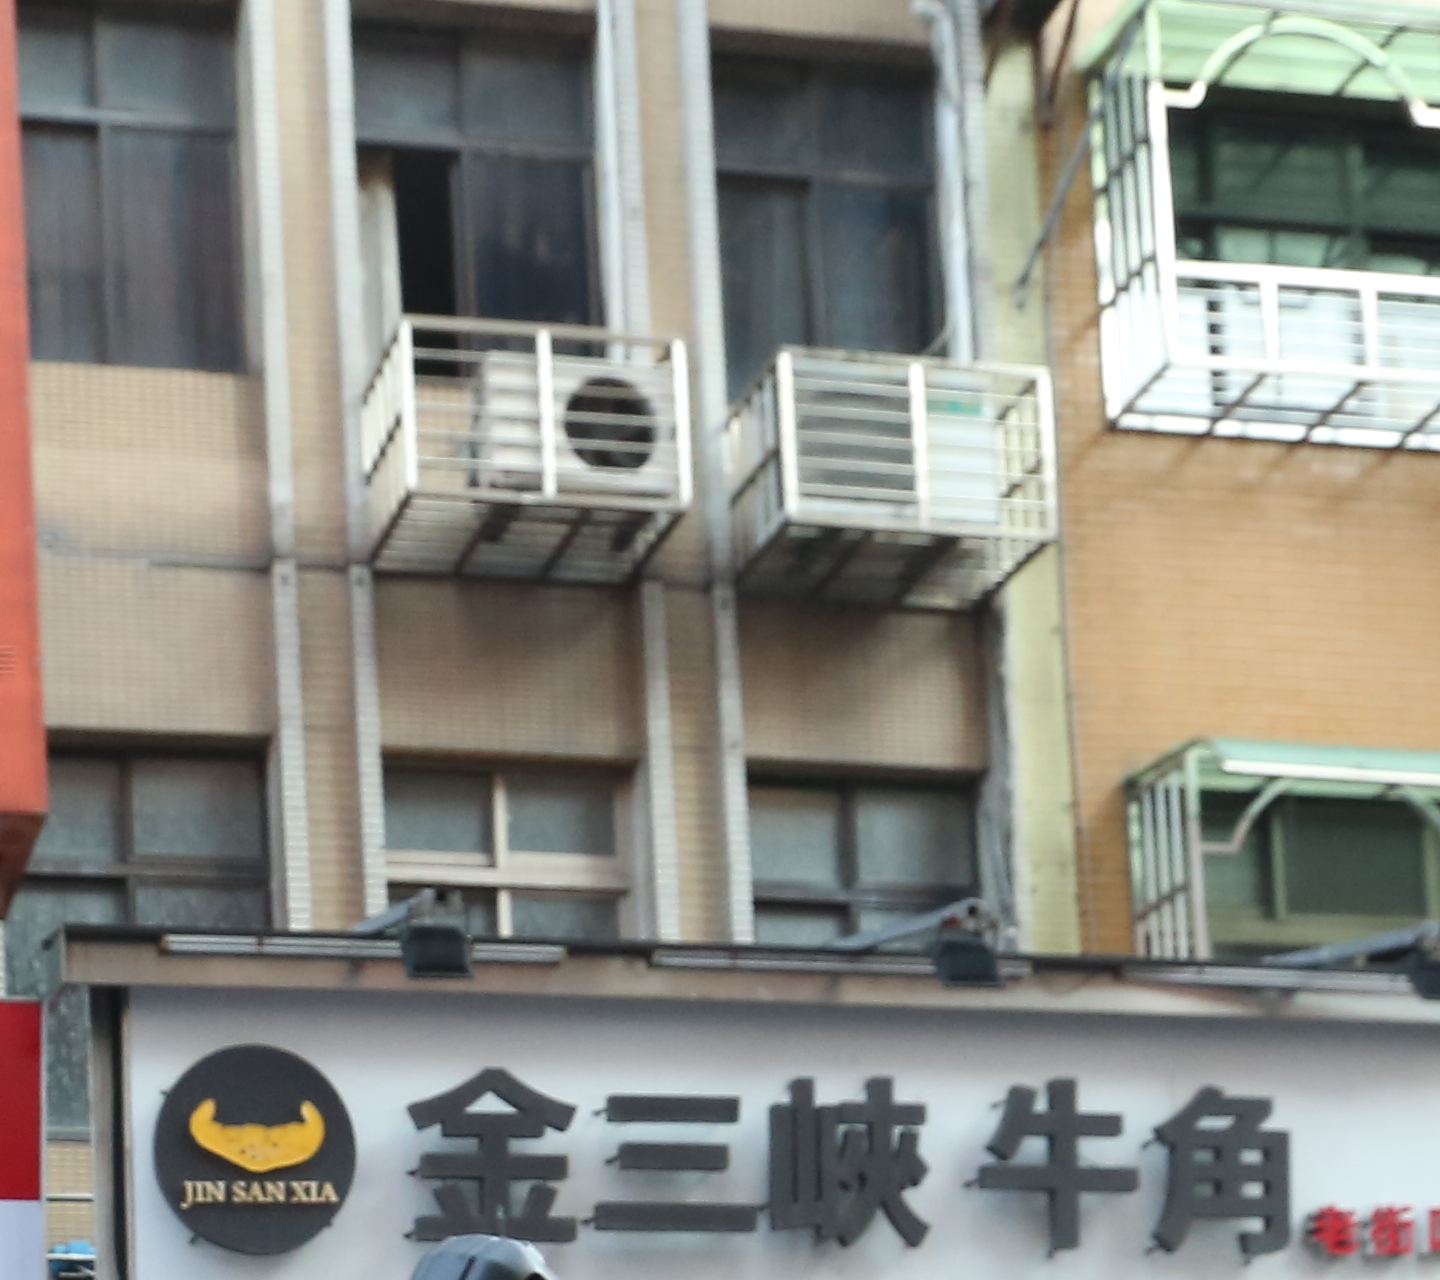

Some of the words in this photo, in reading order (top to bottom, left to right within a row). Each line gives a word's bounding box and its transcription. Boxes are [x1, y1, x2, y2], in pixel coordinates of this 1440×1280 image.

[180, 1179, 227, 1211] JIN
[231, 1179, 287, 1204] SAN
[289, 1179, 341, 1204] XIA
[404, 1066, 1296, 1262] 金三峽牛角
